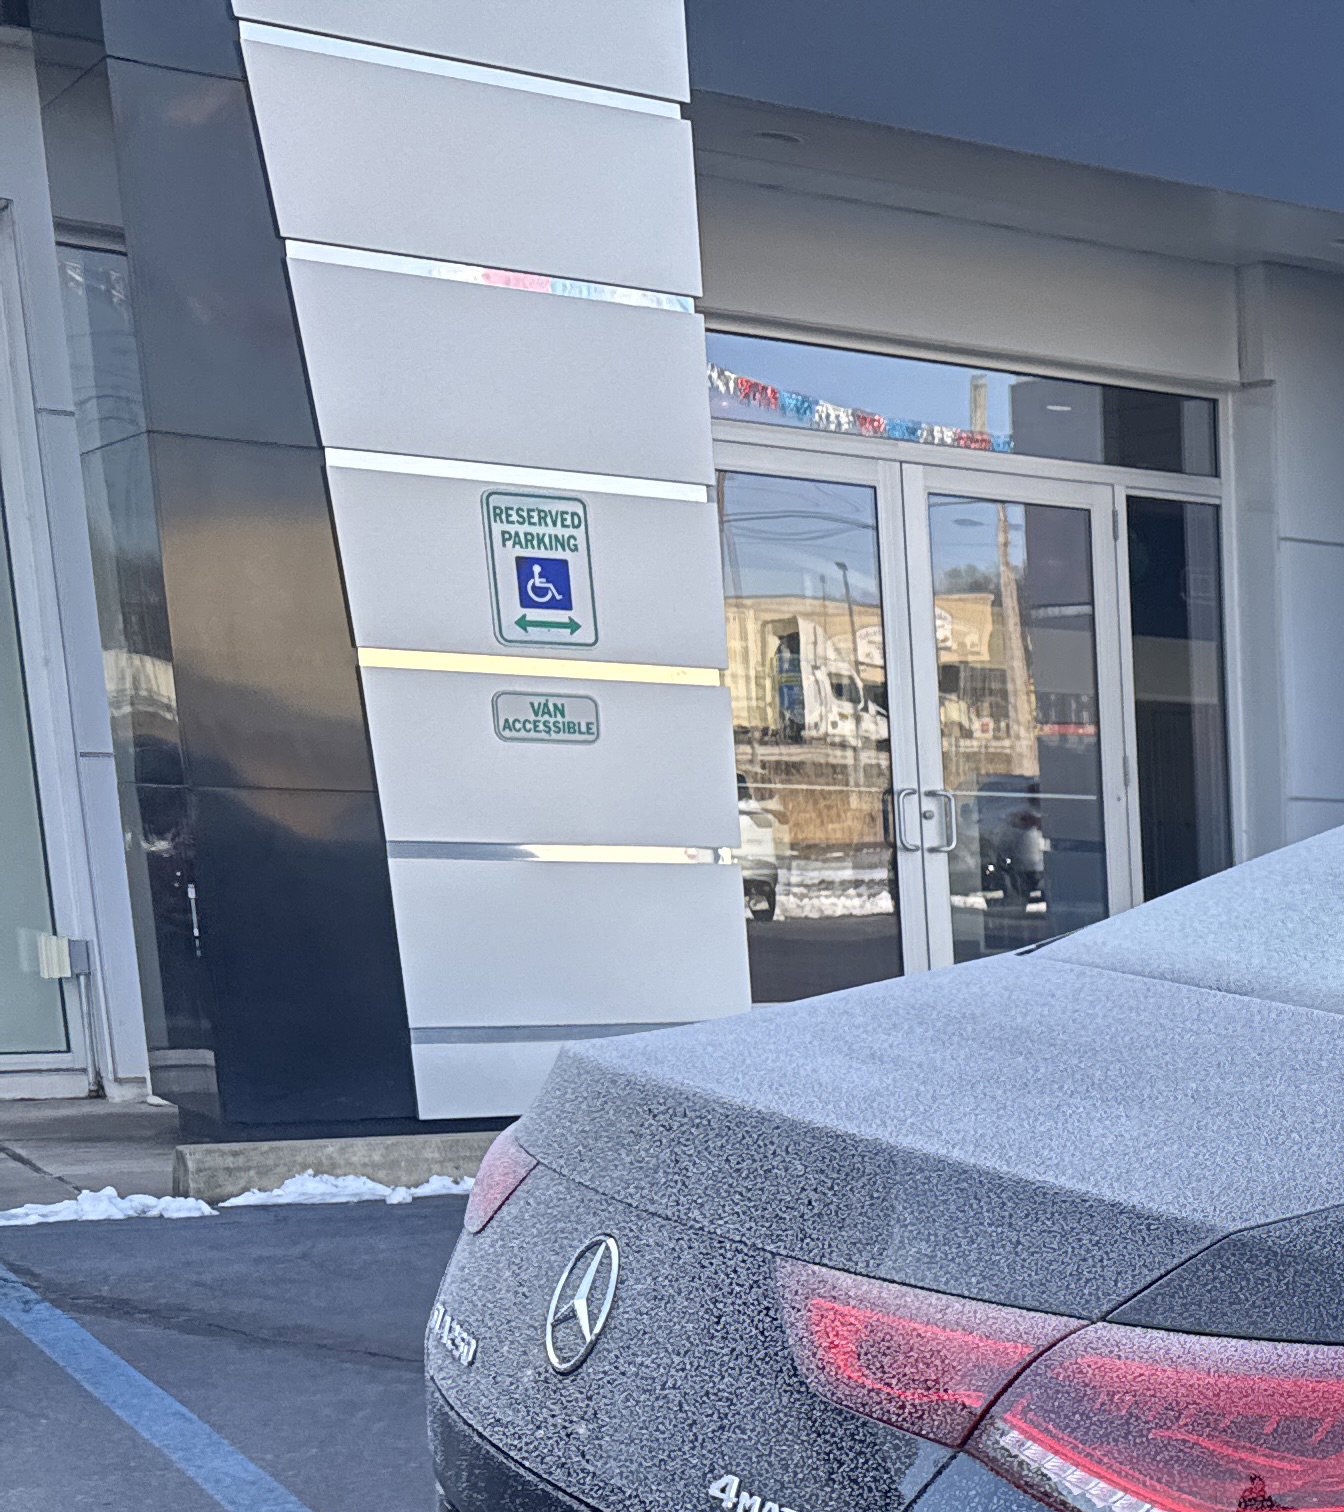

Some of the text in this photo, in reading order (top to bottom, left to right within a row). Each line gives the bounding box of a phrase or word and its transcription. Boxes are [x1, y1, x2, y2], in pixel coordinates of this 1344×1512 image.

[492, 505, 583, 530] RESERVED
[500, 530, 580, 553] PARKING
[529, 700, 566, 719] VAN
[502, 718, 596, 736] ACCESSIBLE
